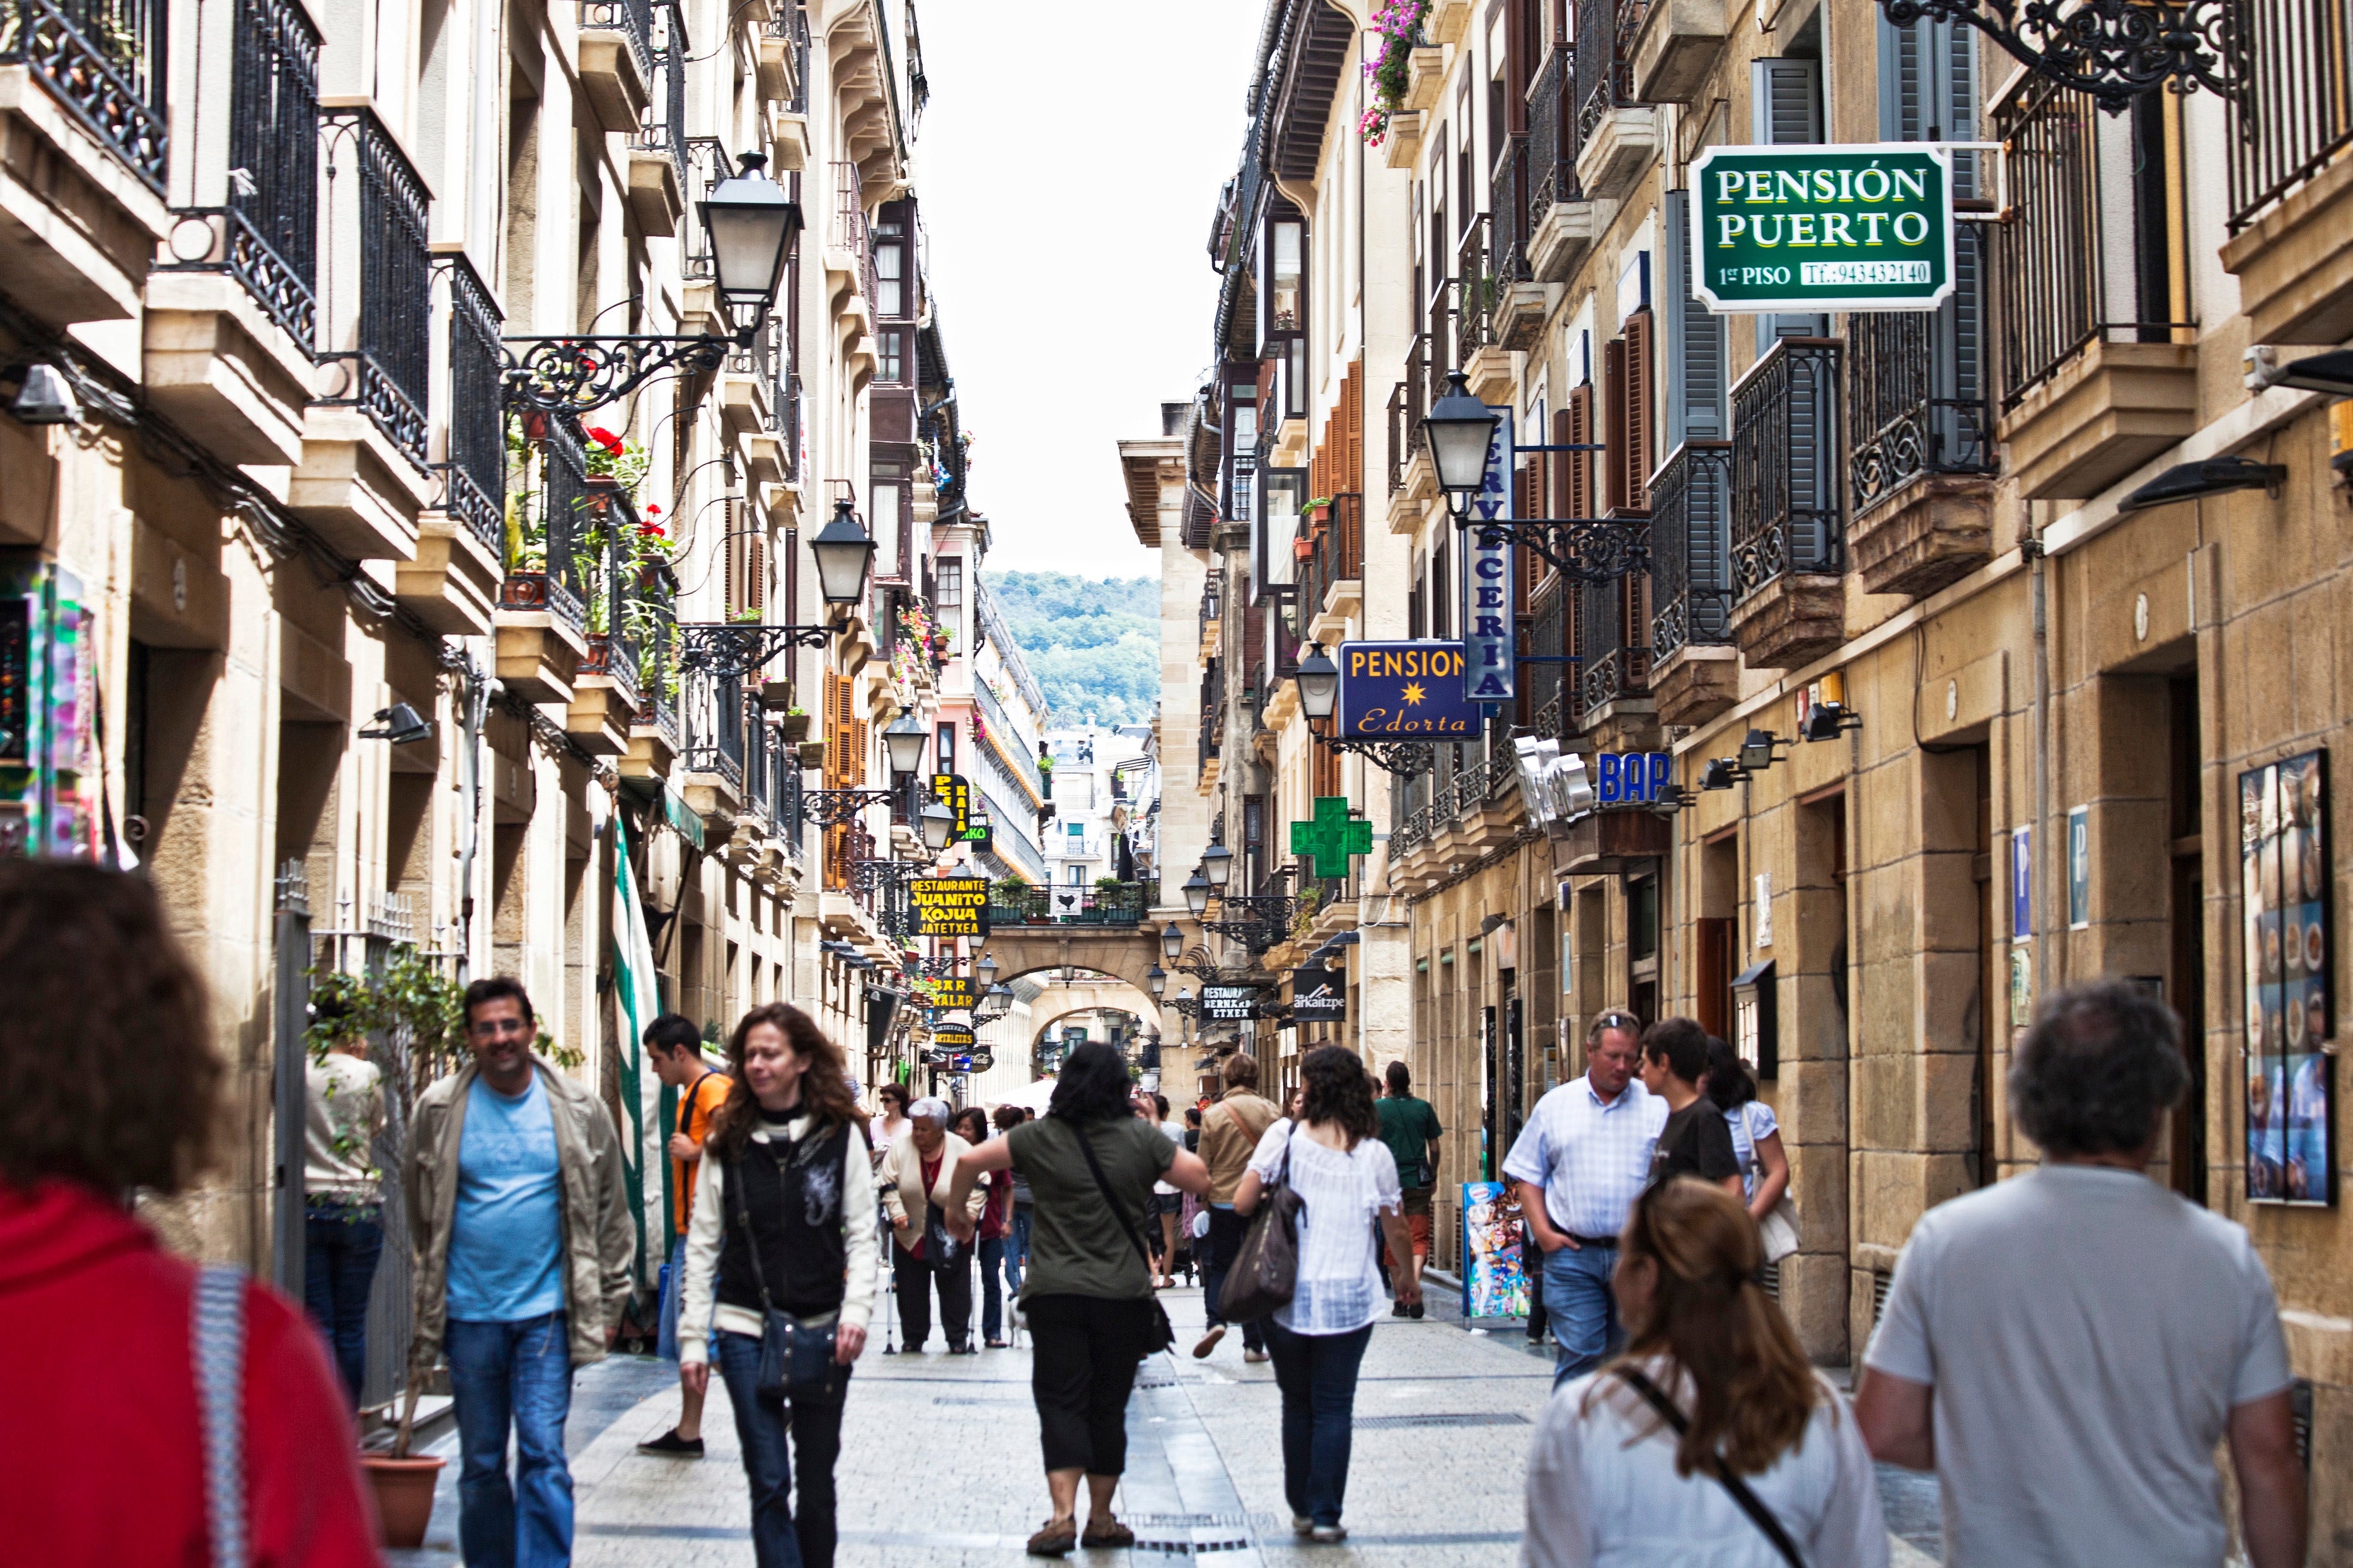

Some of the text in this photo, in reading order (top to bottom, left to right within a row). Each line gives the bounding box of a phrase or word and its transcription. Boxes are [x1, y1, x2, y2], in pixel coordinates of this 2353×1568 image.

[1716, 160, 1928, 203] PENSIÓN
[1717, 212, 1929, 248] PUERTO
[1742, 266, 1791, 285] PISO
[1474, 414, 1507, 695] ERVECERIA
[1351, 650, 1465, 677] PENSION
[1358, 708, 1466, 732] Edorta
[1599, 752, 1670, 802] BAR
[956, 785, 967, 831] KAIA
[2076, 823, 2087, 882] P
[2019, 843, 2028, 897] P
[910, 880, 986, 891] RESTAURANTE
[920, 907, 977, 923] KOJUA
[918, 923, 979, 934] JATETXEA
[933, 979, 966, 991] BAR
[1203, 987, 1257, 999] RESTAURA
[1213, 1009, 1249, 1018] ETXEA
[1293, 996, 1345, 1010] arkaitzpe
